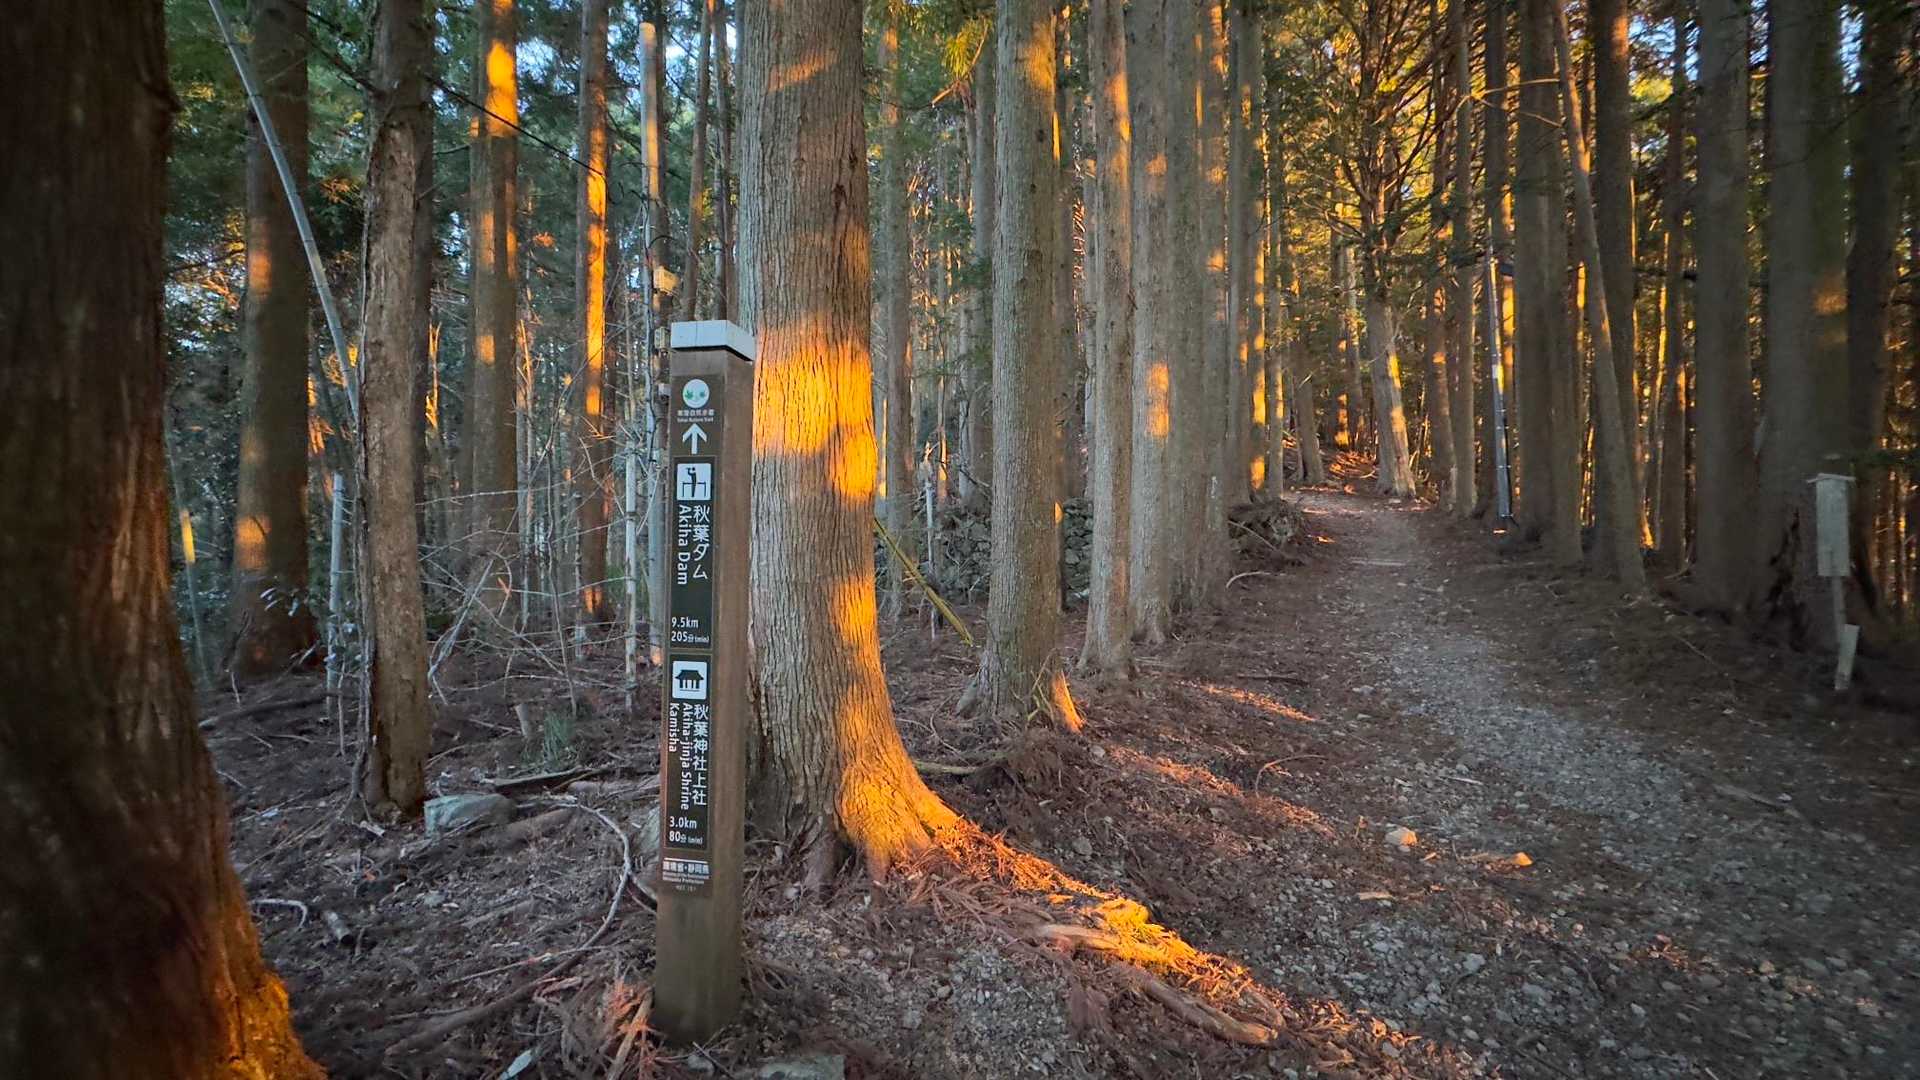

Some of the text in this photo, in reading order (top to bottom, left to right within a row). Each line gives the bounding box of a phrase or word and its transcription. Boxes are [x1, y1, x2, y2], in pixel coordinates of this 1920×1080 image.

[677, 504, 692, 585] Akiha Dam
[692, 504, 710, 580] 秋葉ダム
[671, 616, 699, 628] 9.5km
[668, 702, 680, 753] Kamisha
[680, 702, 693, 810] Akiha-jinja Shrine
[692, 703, 709, 806] 秋葉神社上社
[669, 816, 697, 829] 3.0km
